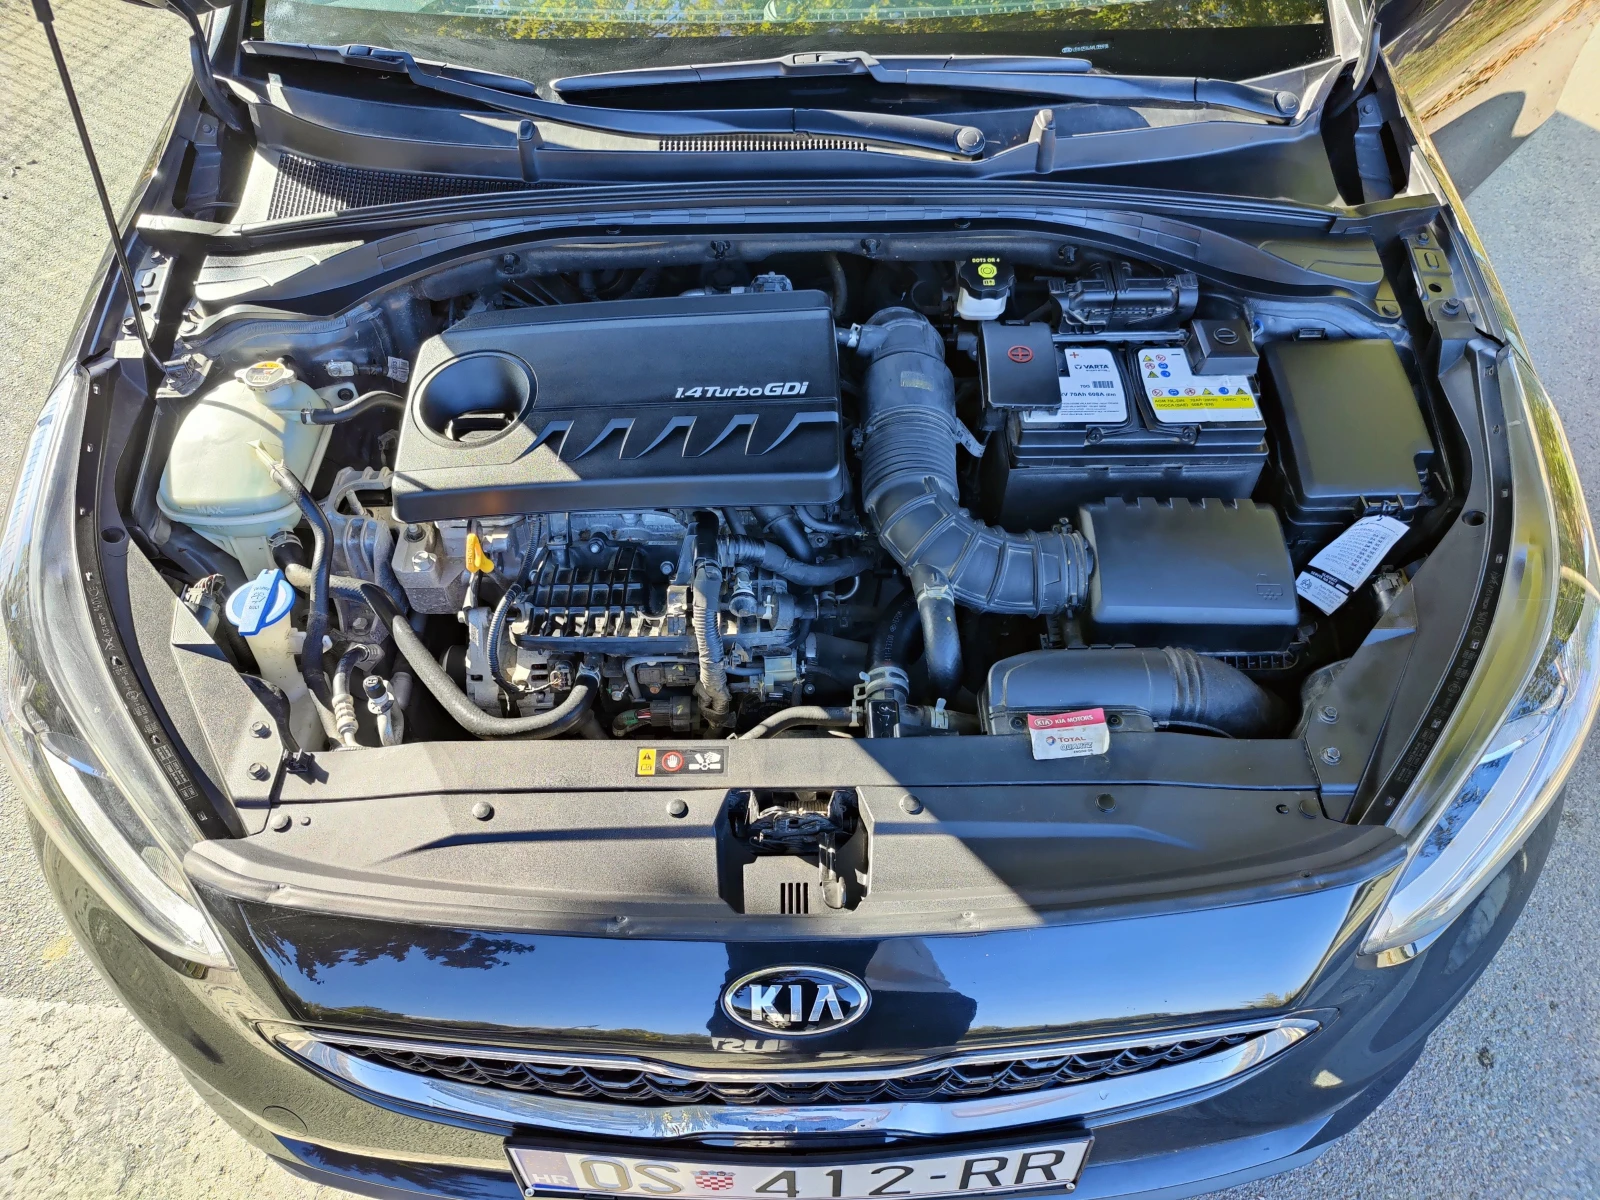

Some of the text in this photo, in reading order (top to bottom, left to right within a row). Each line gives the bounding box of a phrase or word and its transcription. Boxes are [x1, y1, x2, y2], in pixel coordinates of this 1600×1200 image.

[196, 506, 224, 514] MAX
[1067, 715, 1093, 723] MOTORS
[1060, 742, 1093, 751] QUARTZ
[749, 984, 844, 1022] KIA
[532, 1150, 1066, 1198] HR OS 412-RR
